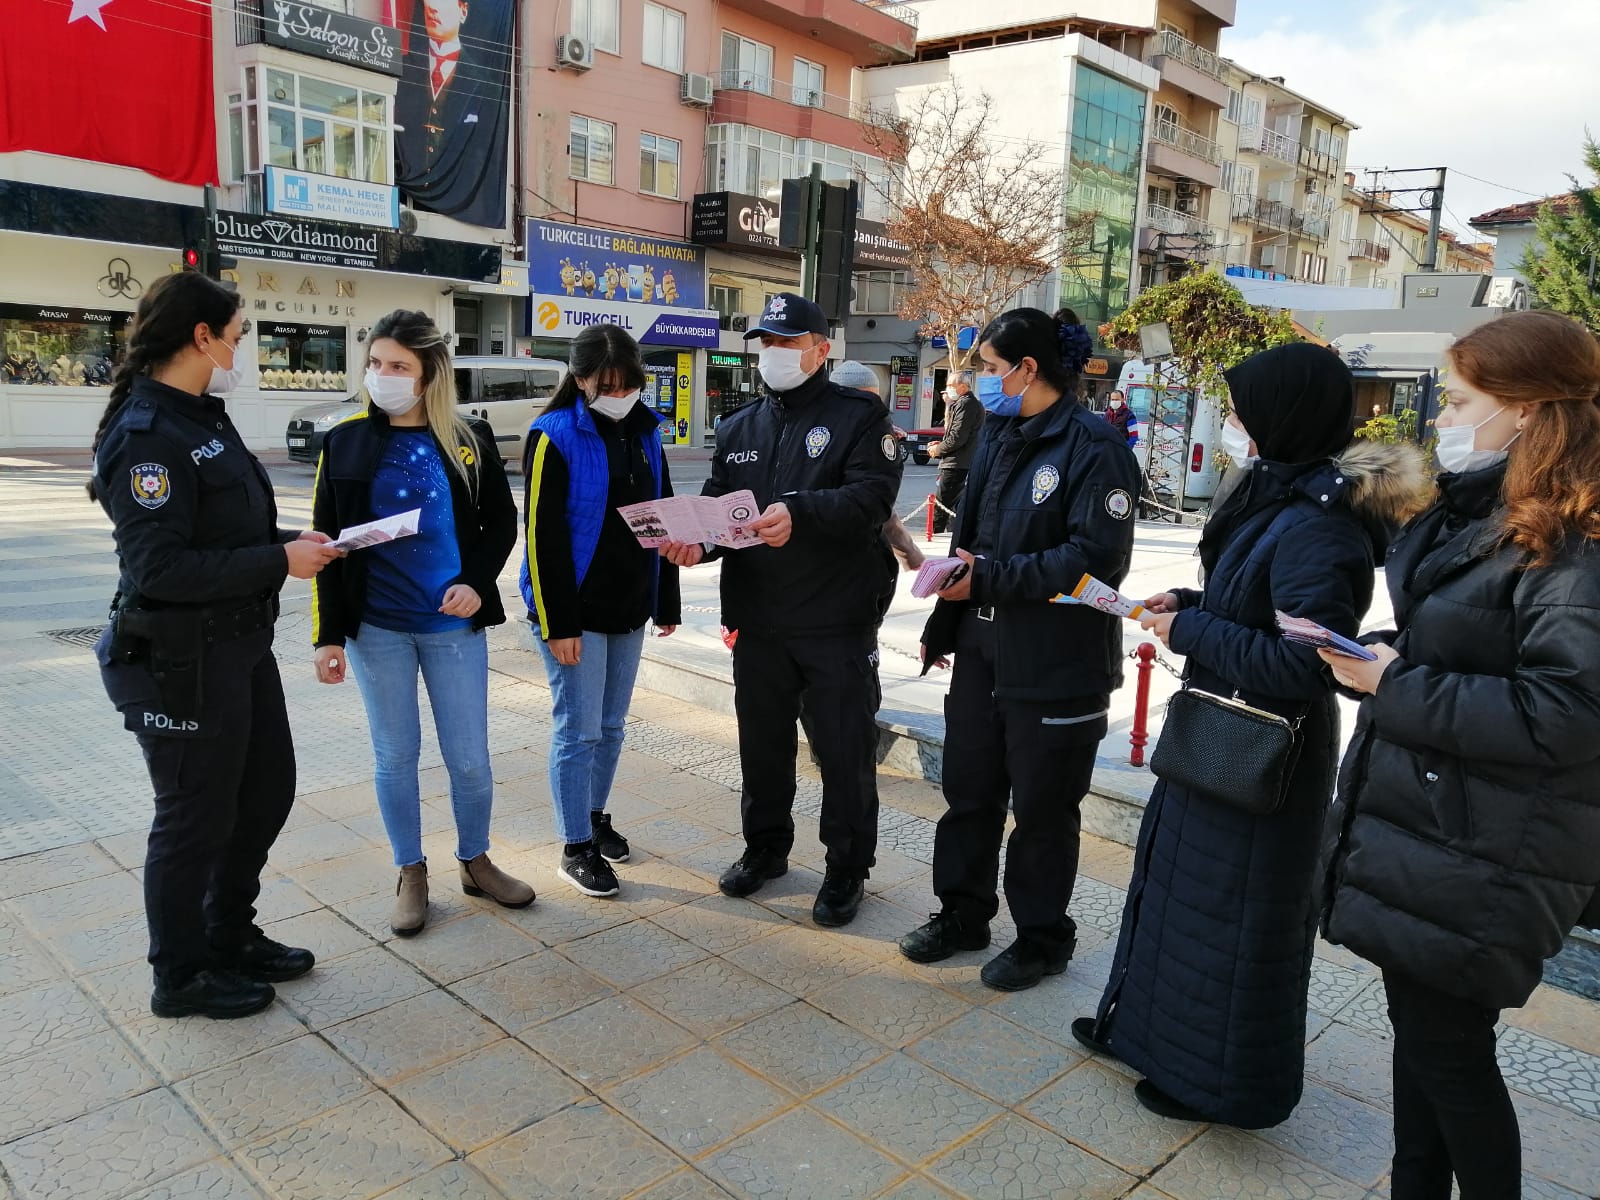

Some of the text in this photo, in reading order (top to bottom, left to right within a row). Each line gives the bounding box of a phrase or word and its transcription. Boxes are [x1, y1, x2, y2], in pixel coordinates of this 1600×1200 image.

[291, 6, 394, 58] Saloon Sis
[317, 184, 385, 202] KEMAL HECE
[214, 214, 263, 240] blue
[290, 223, 378, 253] diamond
[217, 244, 265, 256] AMSTERDAM
[271, 250, 294, 259] DUBAI
[300, 253, 316, 262] NEW
[317, 255, 337, 264] YORK
[612, 238, 655, 257] BAĞLAN
[656, 248, 697, 263] HAYATA!
[564, 310, 633, 330] TURKCELL
[655, 321, 717, 338] BÜYÜKKARDEŞLER
[679, 377, 689, 388] 12
